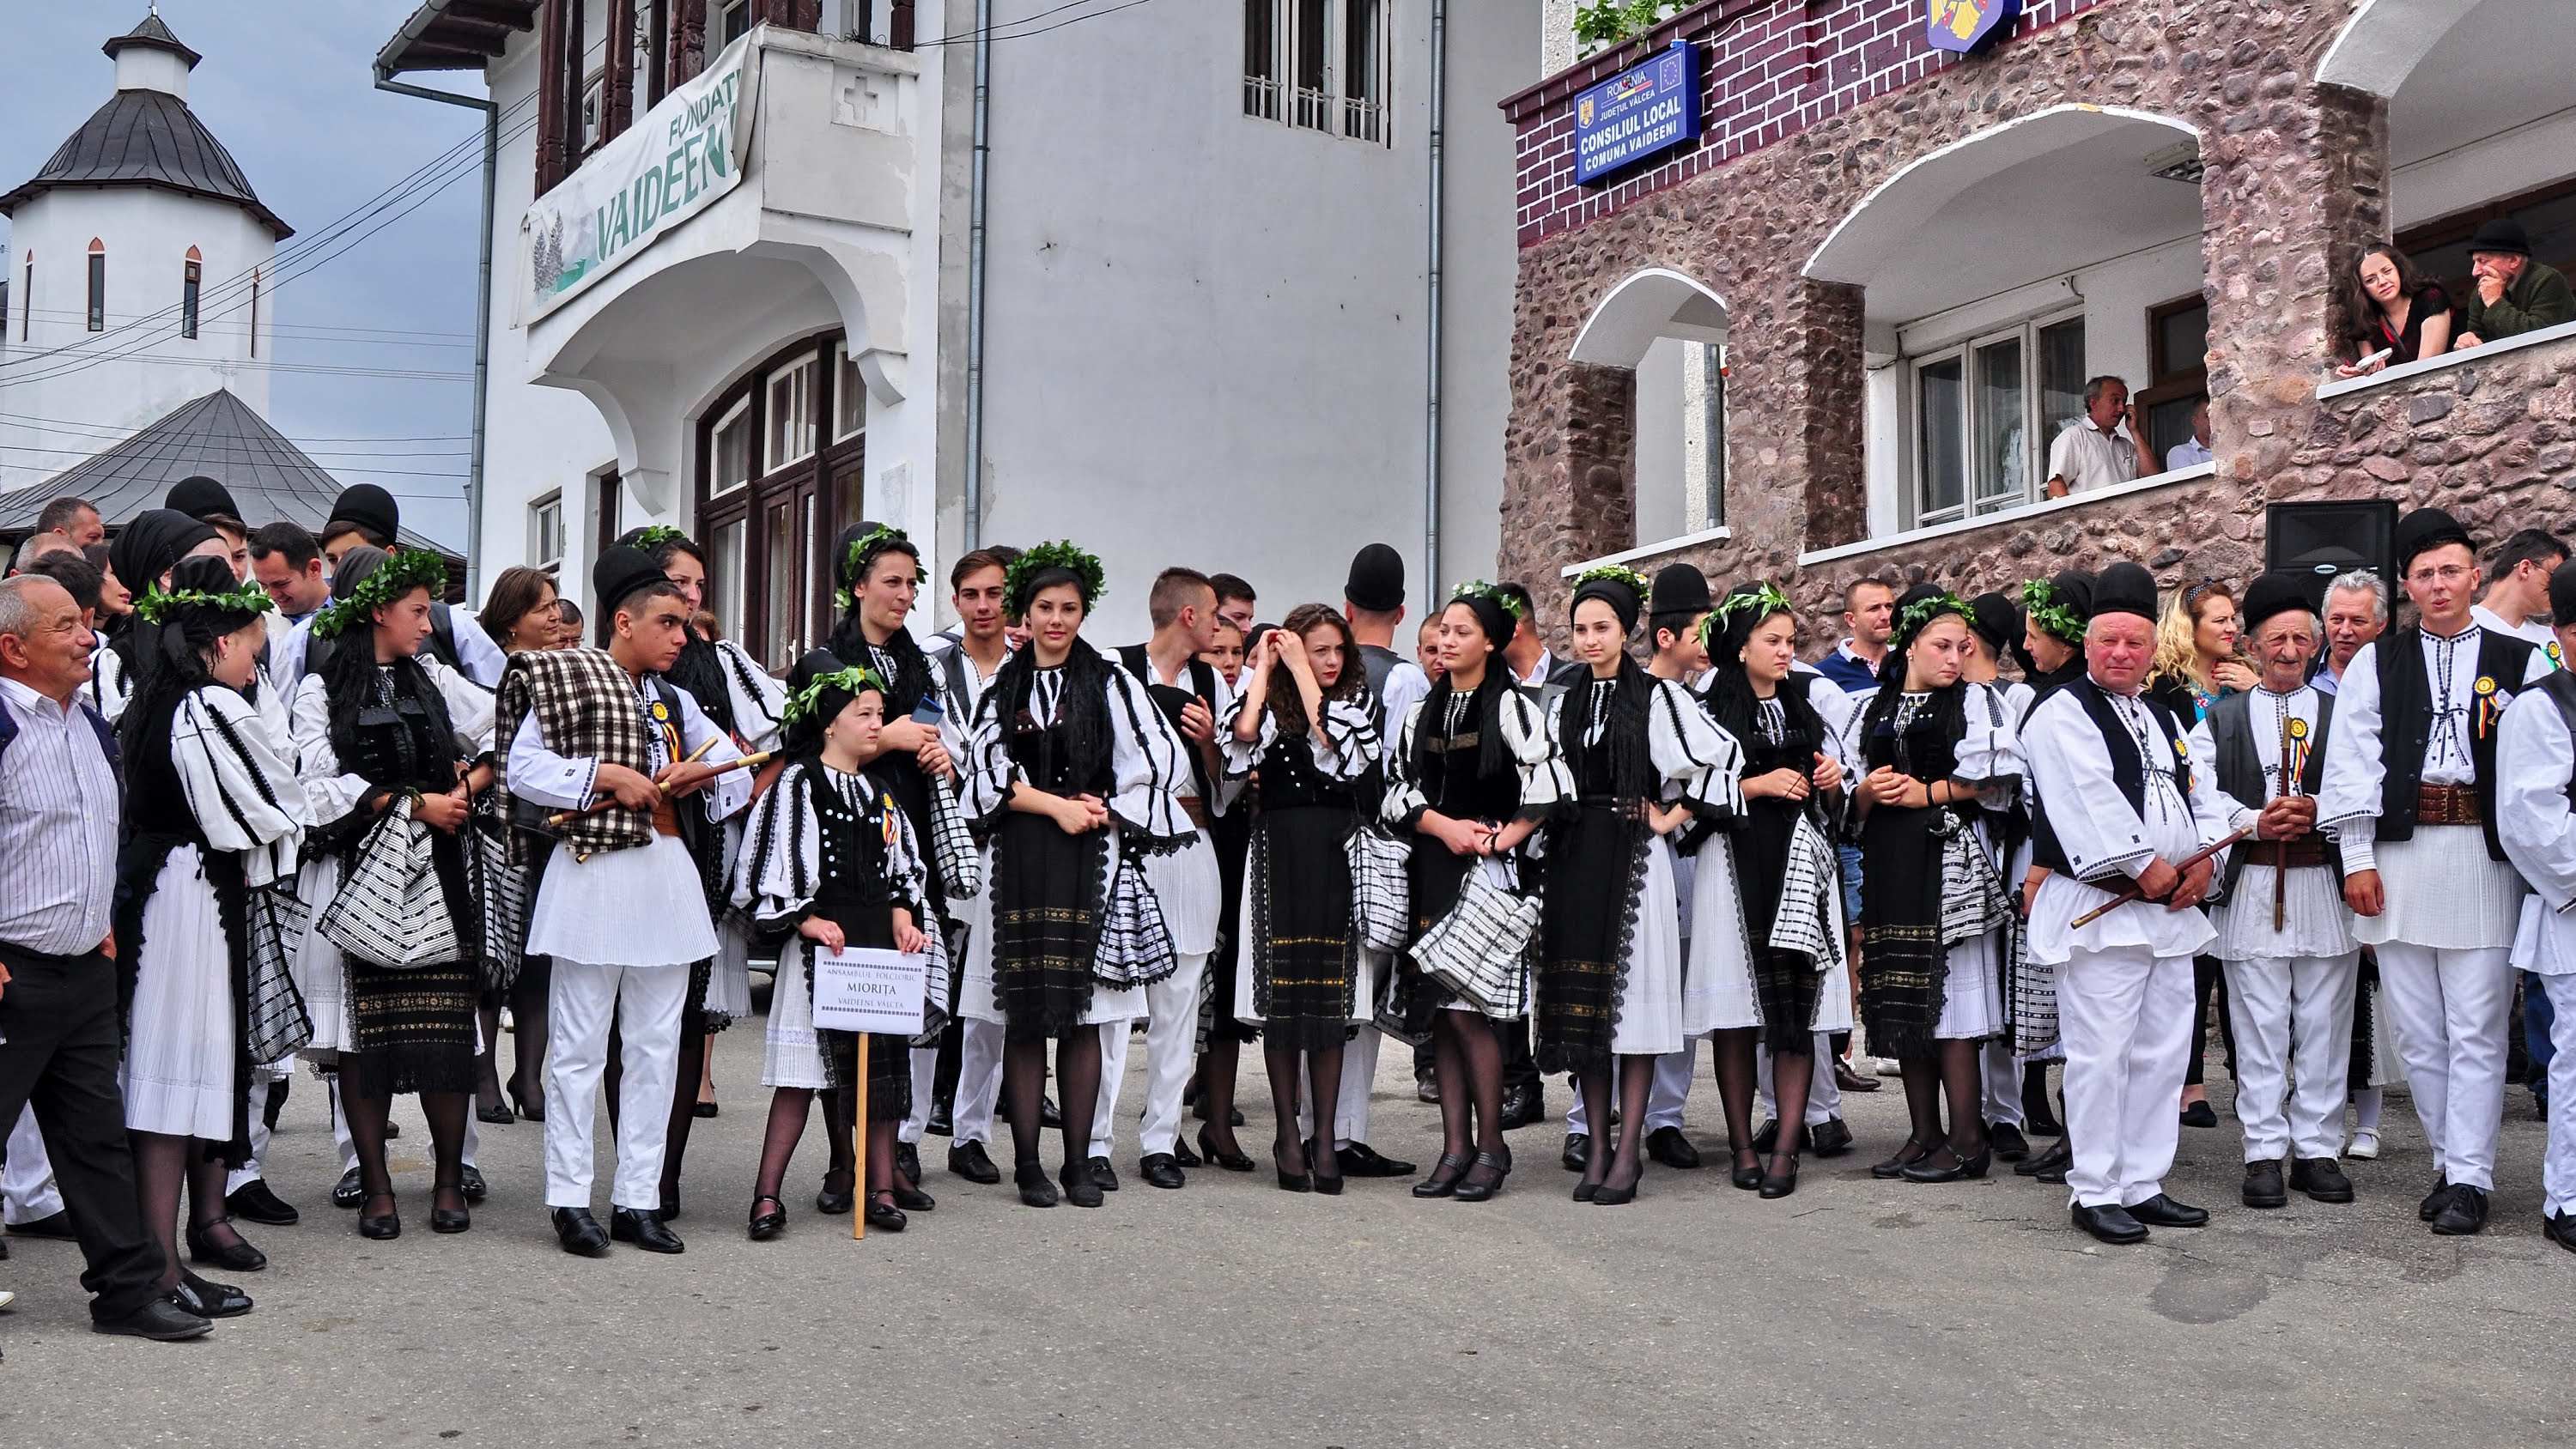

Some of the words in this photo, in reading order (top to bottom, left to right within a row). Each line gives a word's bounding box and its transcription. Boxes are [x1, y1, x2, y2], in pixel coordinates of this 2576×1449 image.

[1581, 114, 1641, 155] CONSILIUL
[1643, 95, 1681, 128] LOCAL
[1585, 142, 1626, 172] COMUNA
[1629, 119, 1677, 152] VAIDEENI
[827, 968, 872, 978] ANSAMBLUL
[876, 972, 917, 982] FOLCLORIC
[847, 982, 896, 996] MIORIȚA
[838, 997, 873, 1007] VAIDEENI
